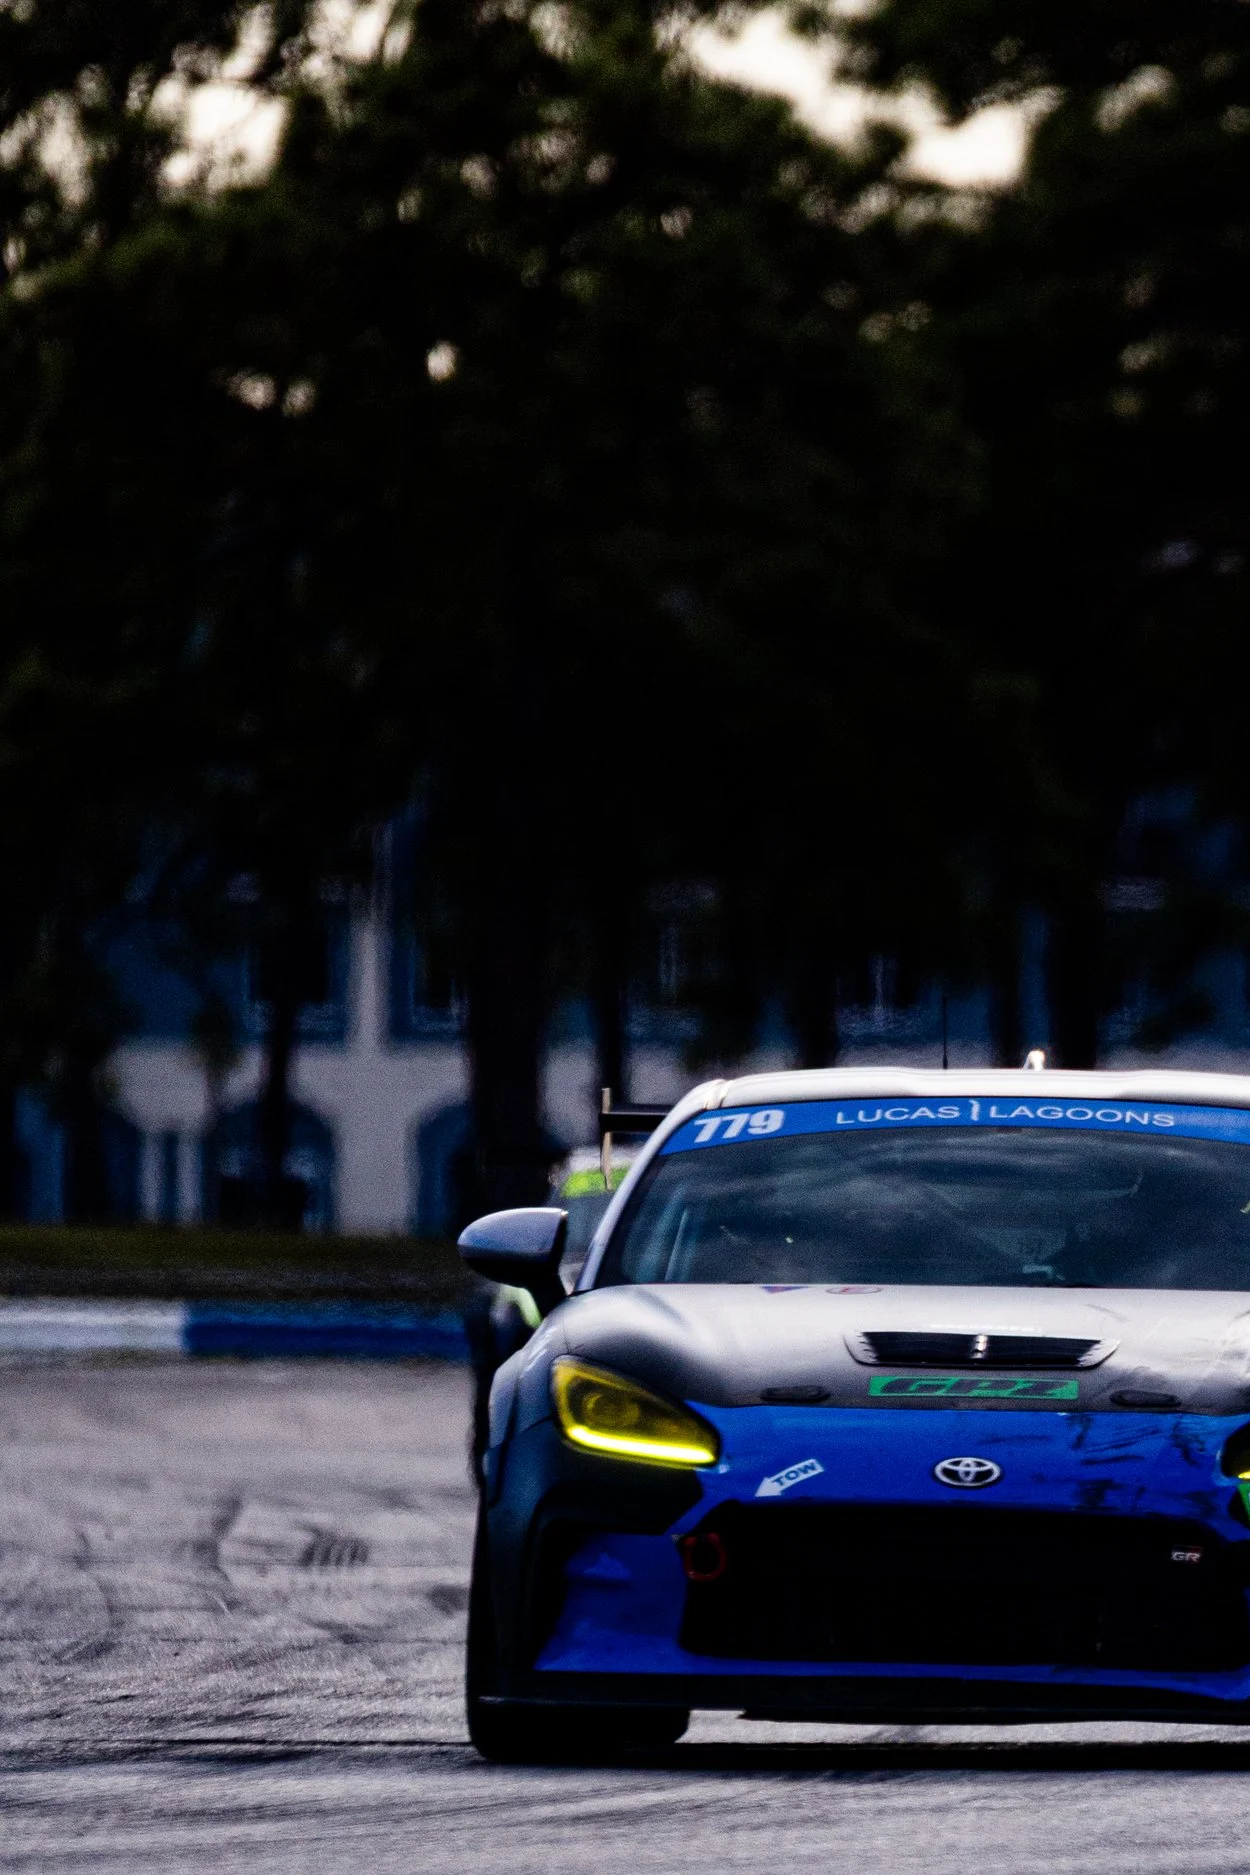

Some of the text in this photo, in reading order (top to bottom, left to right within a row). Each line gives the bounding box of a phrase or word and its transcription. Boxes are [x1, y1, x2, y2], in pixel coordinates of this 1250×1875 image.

[694, 1109, 785, 1143] 779
[836, 1105, 1175, 1128] LUCAS LAGOONS
[771, 1462, 817, 1486] TOW
[1171, 1551, 1201, 1562] GR
